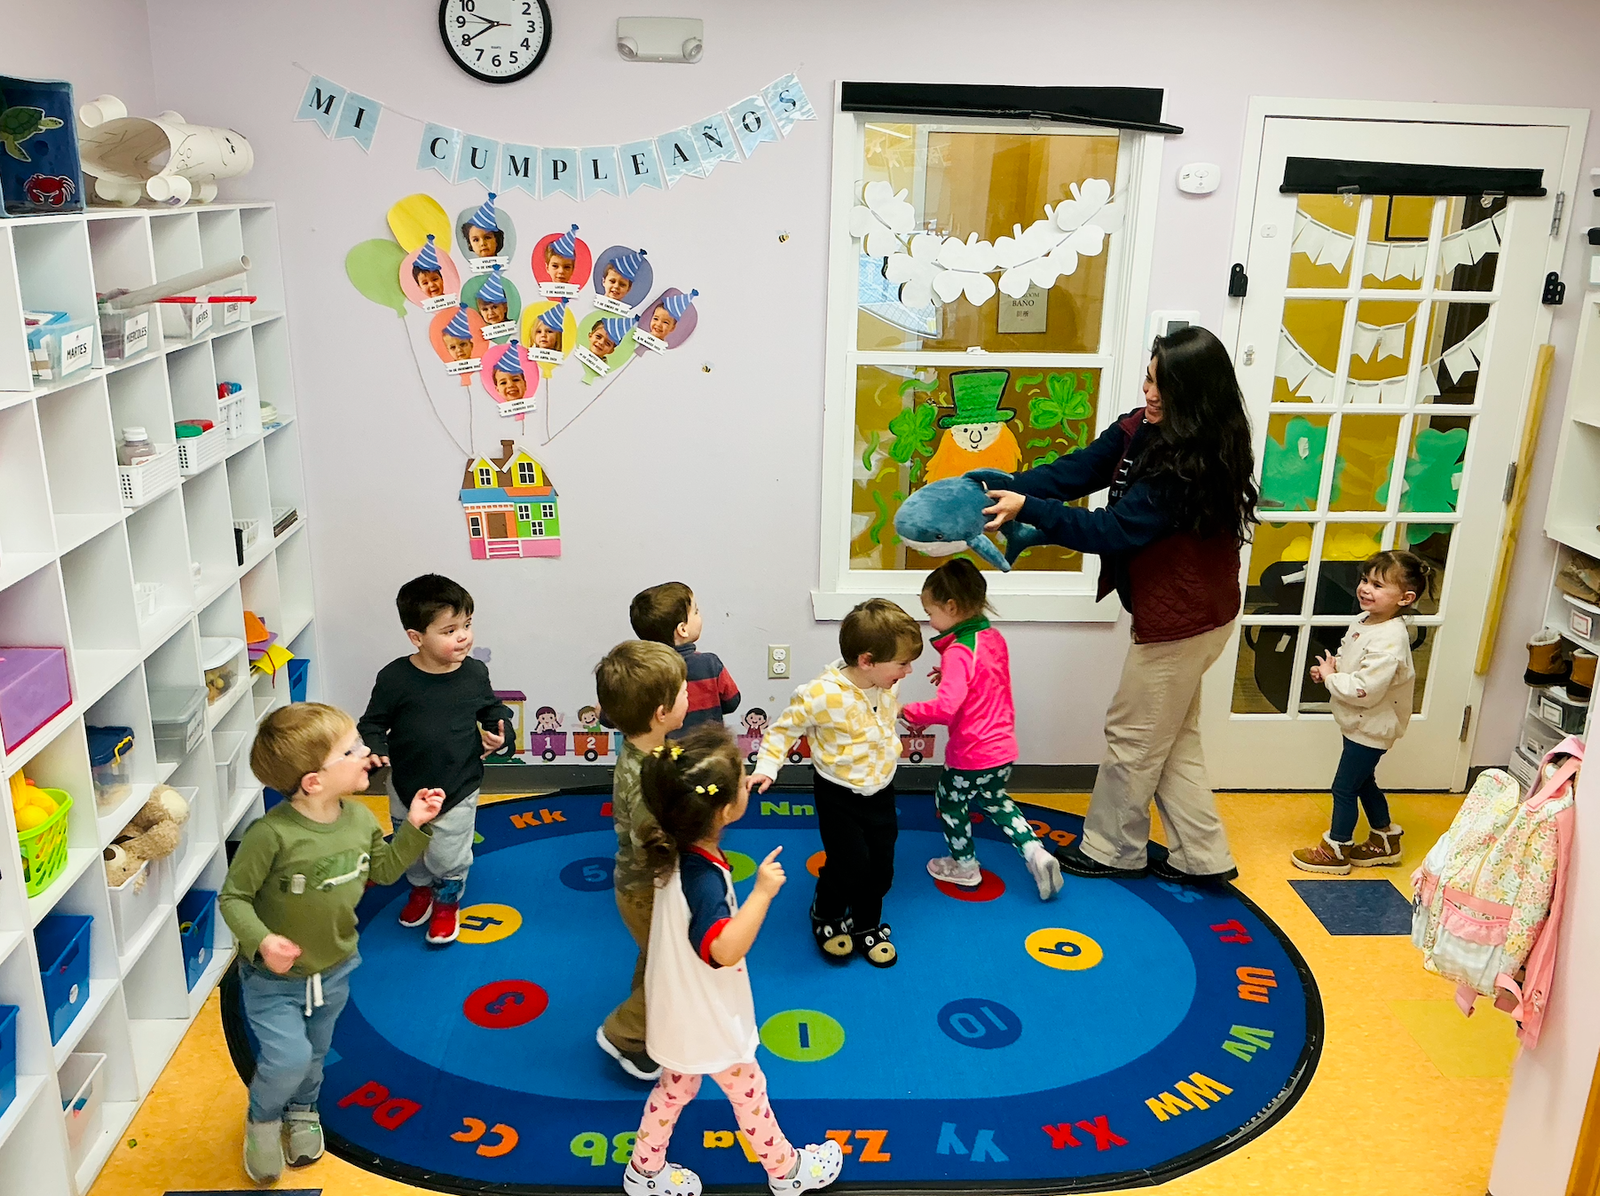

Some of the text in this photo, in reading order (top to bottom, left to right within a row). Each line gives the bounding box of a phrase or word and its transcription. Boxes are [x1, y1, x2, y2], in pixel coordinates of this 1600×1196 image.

[459, 0, 475, 12] 10
[522, 2, 531, 15] 2
[456, 15, 466, 28] 9
[527, 20, 536, 33] 3
[461, 34, 471, 46] 8
[520, 38, 531, 50] 4
[475, 48, 485, 61] 7
[492, 55, 501, 67] 6
[509, 51, 518, 64] 5
[308, 86, 797, 181] MI CUMPLEAÑOS
[66, 342, 87, 360] MARTES
[544, 737, 552, 749] 1
[586, 737, 596, 749] 2
[751, 739, 760, 750] 6
[909, 739, 925, 750] 10
[760, 801, 814, 816] Nn
[509, 808, 567, 829] Kk
[582, 864, 608, 883] 5
[460, 915, 504, 932] 4
[1209, 919, 1253, 945] Tt
[1235, 966, 1278, 1004] Uu
[485, 991, 525, 1015] 3
[949, 1005, 1008, 1039] 10
[798, 1022, 810, 1049] 1
[1221, 1024, 1275, 1063] Vv
[336, 1080, 423, 1131] Dd
[1144, 1071, 1234, 1122] Ww
[450, 1117, 519, 1158] Cc
[936, 1121, 1010, 1163] Yy
[1041, 1115, 1130, 1152] Xx
[825, 1129, 891, 1162] Zz
